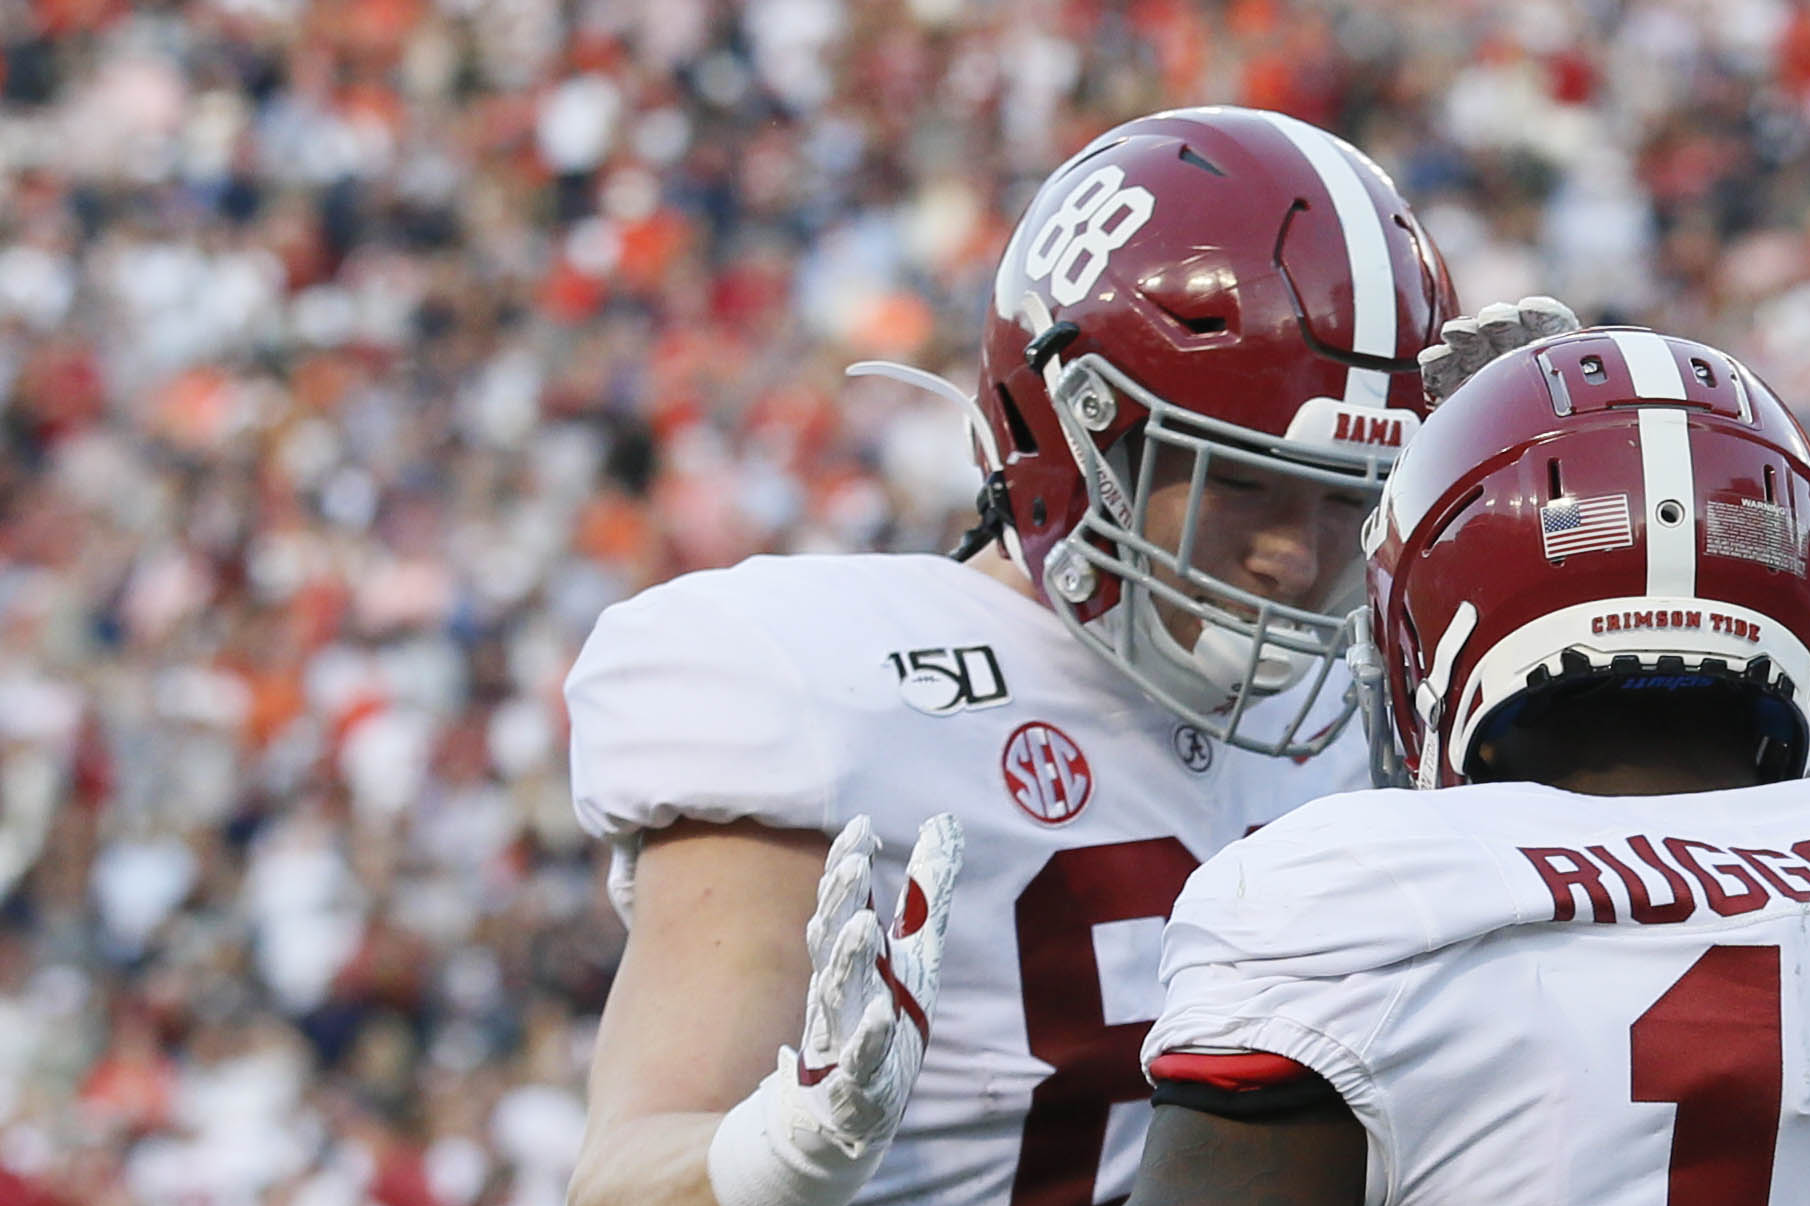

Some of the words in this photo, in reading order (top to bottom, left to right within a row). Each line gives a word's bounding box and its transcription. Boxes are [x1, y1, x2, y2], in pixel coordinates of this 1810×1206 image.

[1025, 164, 1156, 307] 88
[1333, 412, 1402, 447] BAMA
[1591, 610, 1702, 634] CRIMSON
[1710, 613, 1761, 642] TIDE
[1005, 728, 1088, 818] SEC
